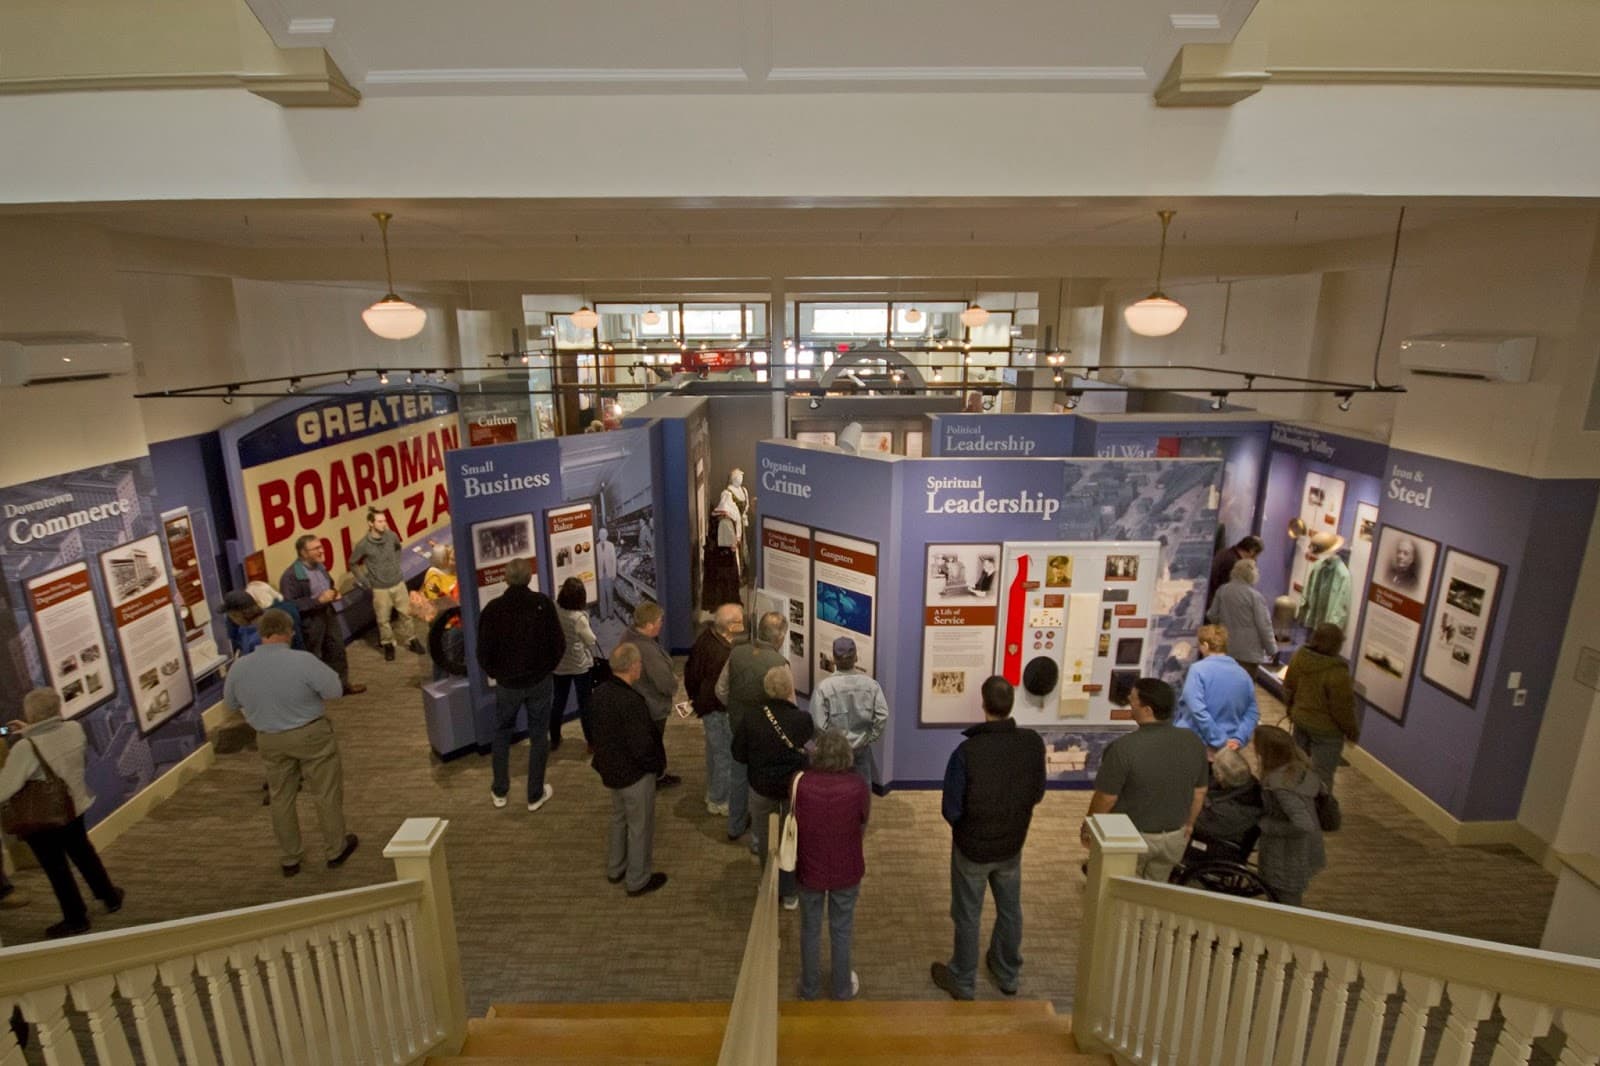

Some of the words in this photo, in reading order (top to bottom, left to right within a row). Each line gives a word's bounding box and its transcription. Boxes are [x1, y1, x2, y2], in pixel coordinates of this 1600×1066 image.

[295, 395, 433, 444] GREATER
[477, 415, 519, 428] Culture
[946, 424, 982, 434] Political
[945, 435, 1036, 454] Leadership
[461, 461, 494, 475] Small
[761, 456, 807, 475] Organized
[1392, 464, 1413, 480] Iron
[1414, 471, 1425, 483] &
[464, 473, 551, 498] Business
[762, 470, 812, 499] Crime
[927, 475, 983, 492] Spiritual
[1387, 478, 1433, 509] Steel
[4, 493, 74, 518] Downtown
[926, 490, 1060, 520] Leadership
[9, 498, 130, 544] Commerce
[820, 547, 854, 565] Gangsters
[934, 616, 966, 625] Service
